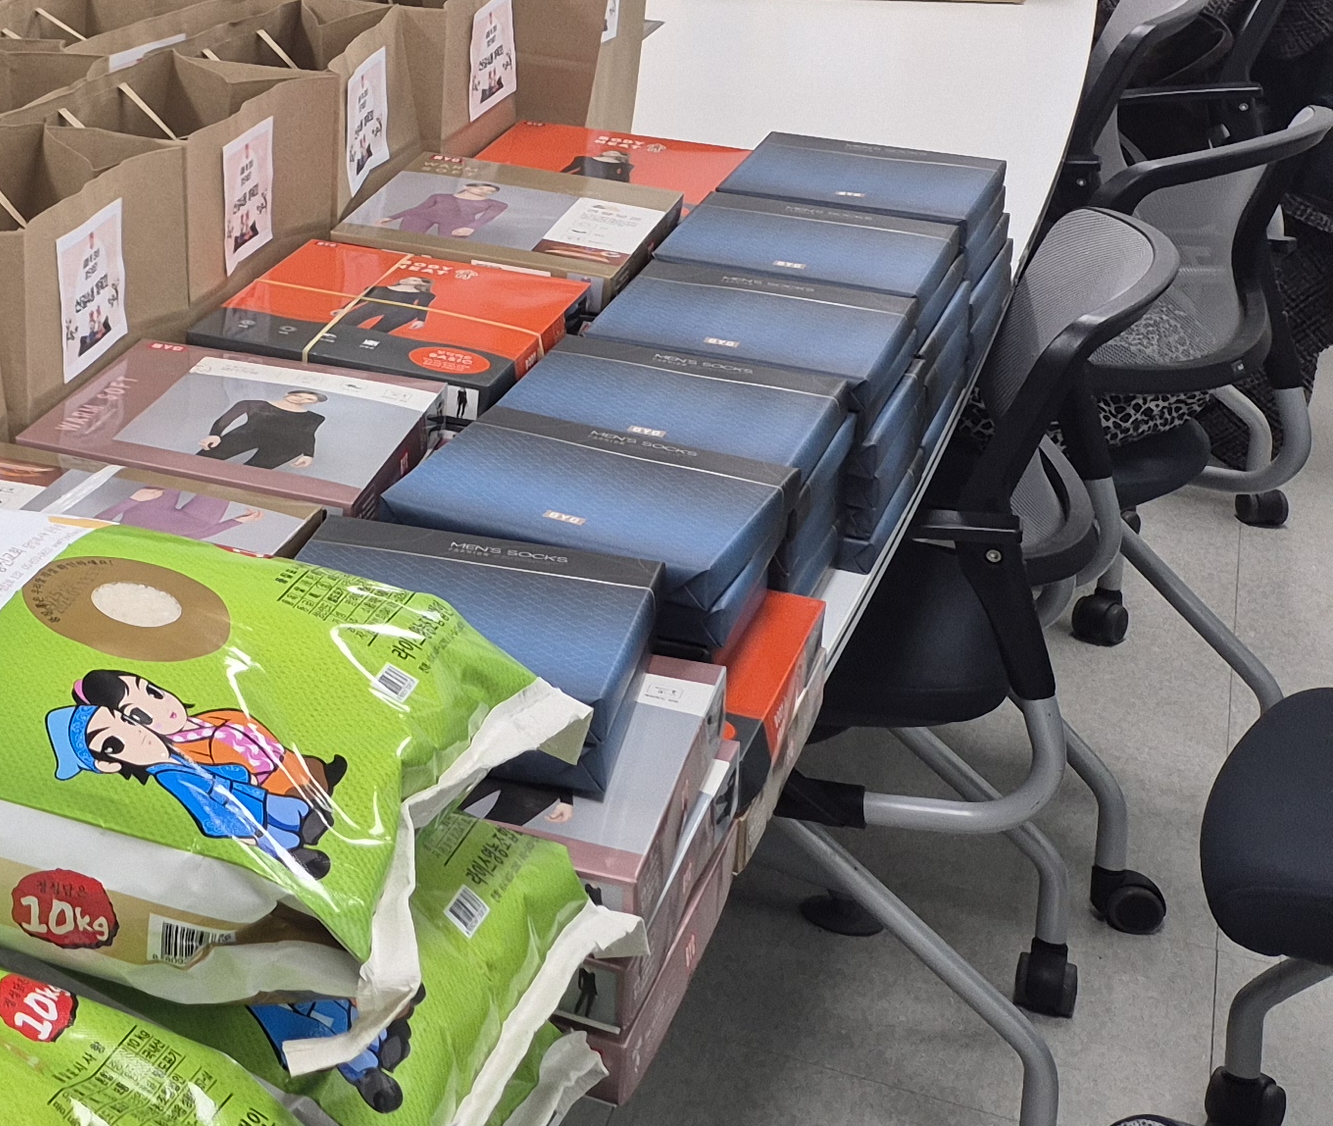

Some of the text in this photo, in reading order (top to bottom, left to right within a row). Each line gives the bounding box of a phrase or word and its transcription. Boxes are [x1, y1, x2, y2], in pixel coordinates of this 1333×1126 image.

[597, 135, 646, 147] BODY
[653, 353, 754, 374] MEN'S SOCKS
[54, 377, 138, 432] WARM SOFT
[590, 430, 698, 457] MEN'S SOCKS
[450, 541, 569, 564] MEN'S SOCKS
[19, 894, 110, 942] 10kg
[127, 1037, 140, 1052] 10
